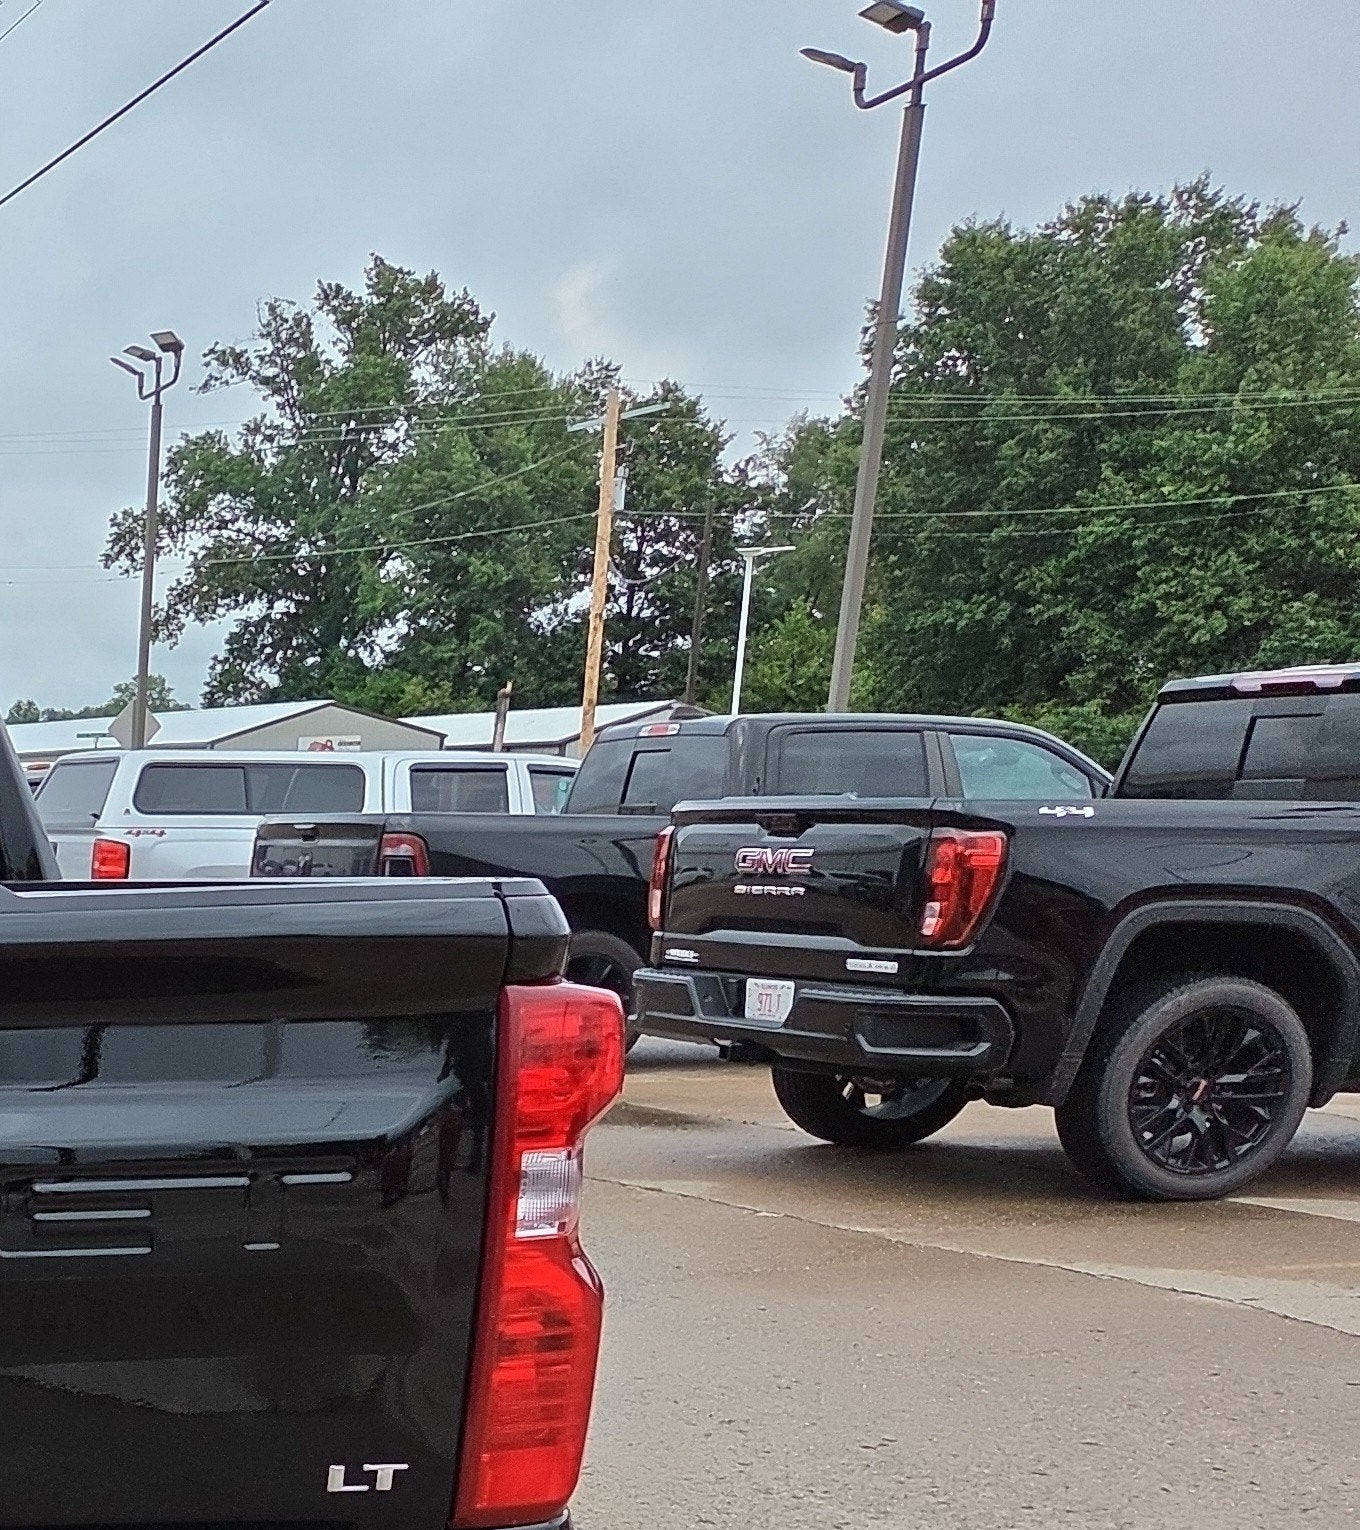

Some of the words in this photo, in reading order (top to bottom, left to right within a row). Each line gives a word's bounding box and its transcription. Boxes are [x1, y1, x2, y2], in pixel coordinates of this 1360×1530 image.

[734, 847, 815, 874] GMC
[733, 884, 806, 896] SIERRA
[327, 1463, 409, 1492] LT
